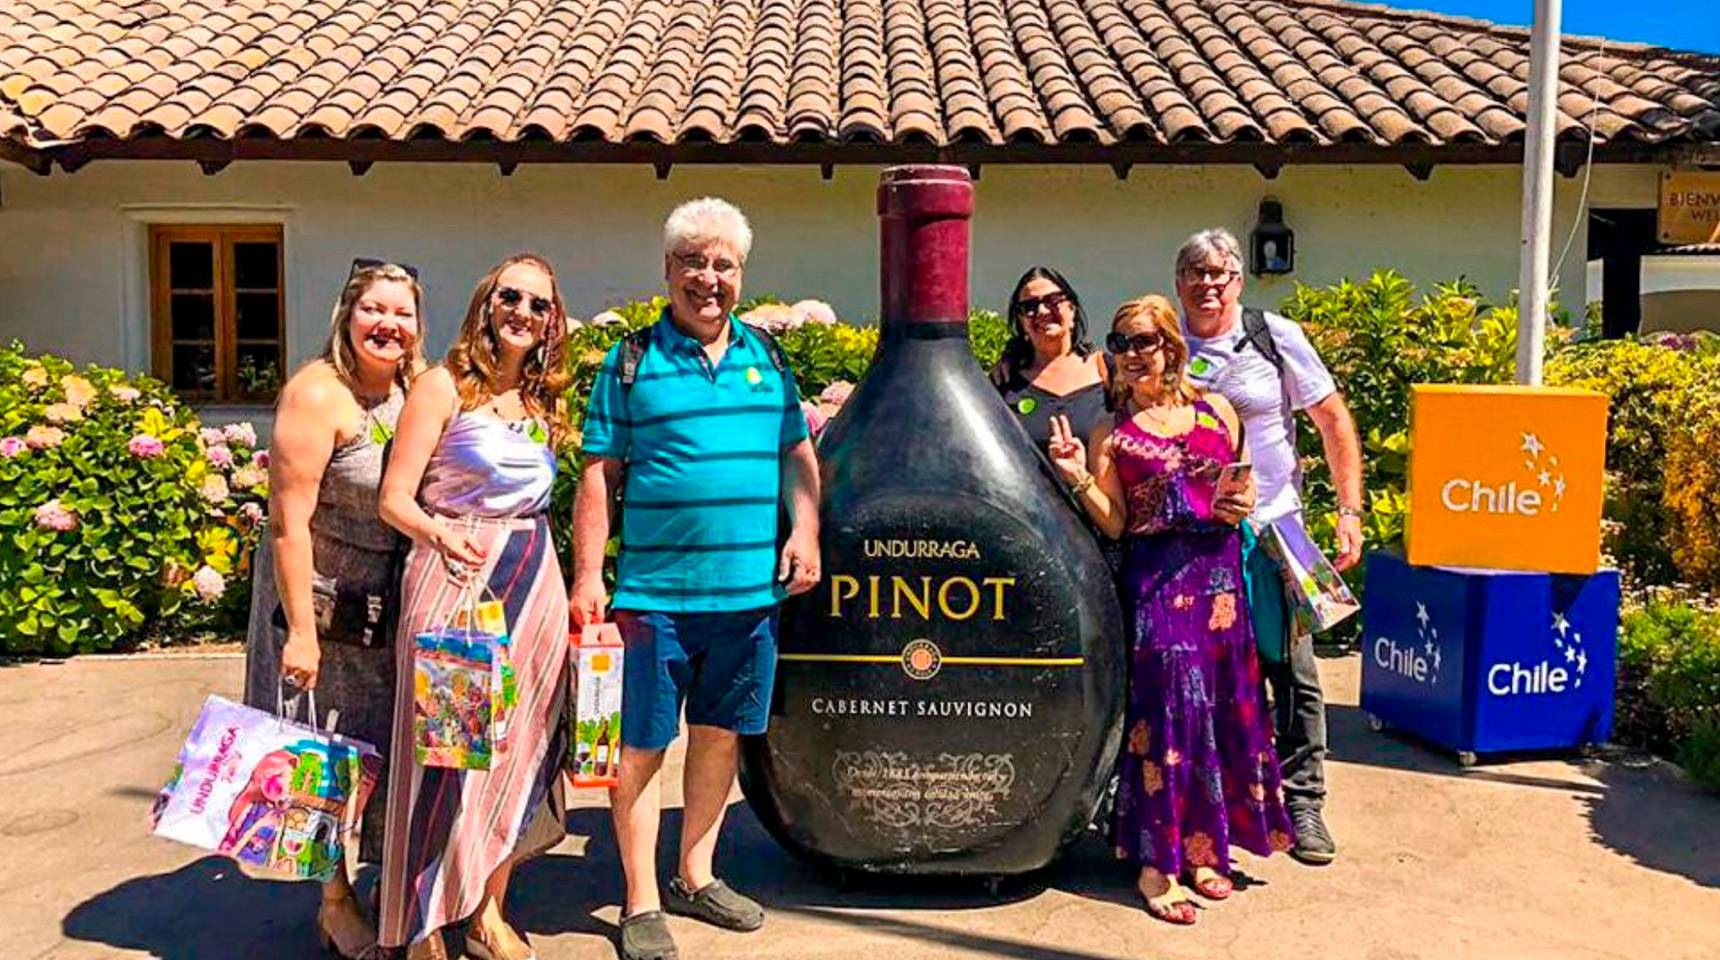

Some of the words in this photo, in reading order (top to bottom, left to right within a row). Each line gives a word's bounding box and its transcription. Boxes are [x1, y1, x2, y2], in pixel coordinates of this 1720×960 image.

[1441, 478, 1542, 516] Chile
[863, 539, 982, 560] UNDURRAGA
[829, 574, 1016, 621] PINOT
[1374, 637, 1428, 682] Chile
[1487, 660, 1569, 696] Chile
[811, 697, 910, 717] CABERNET
[916, 700, 1033, 718] SAUVIGNON
